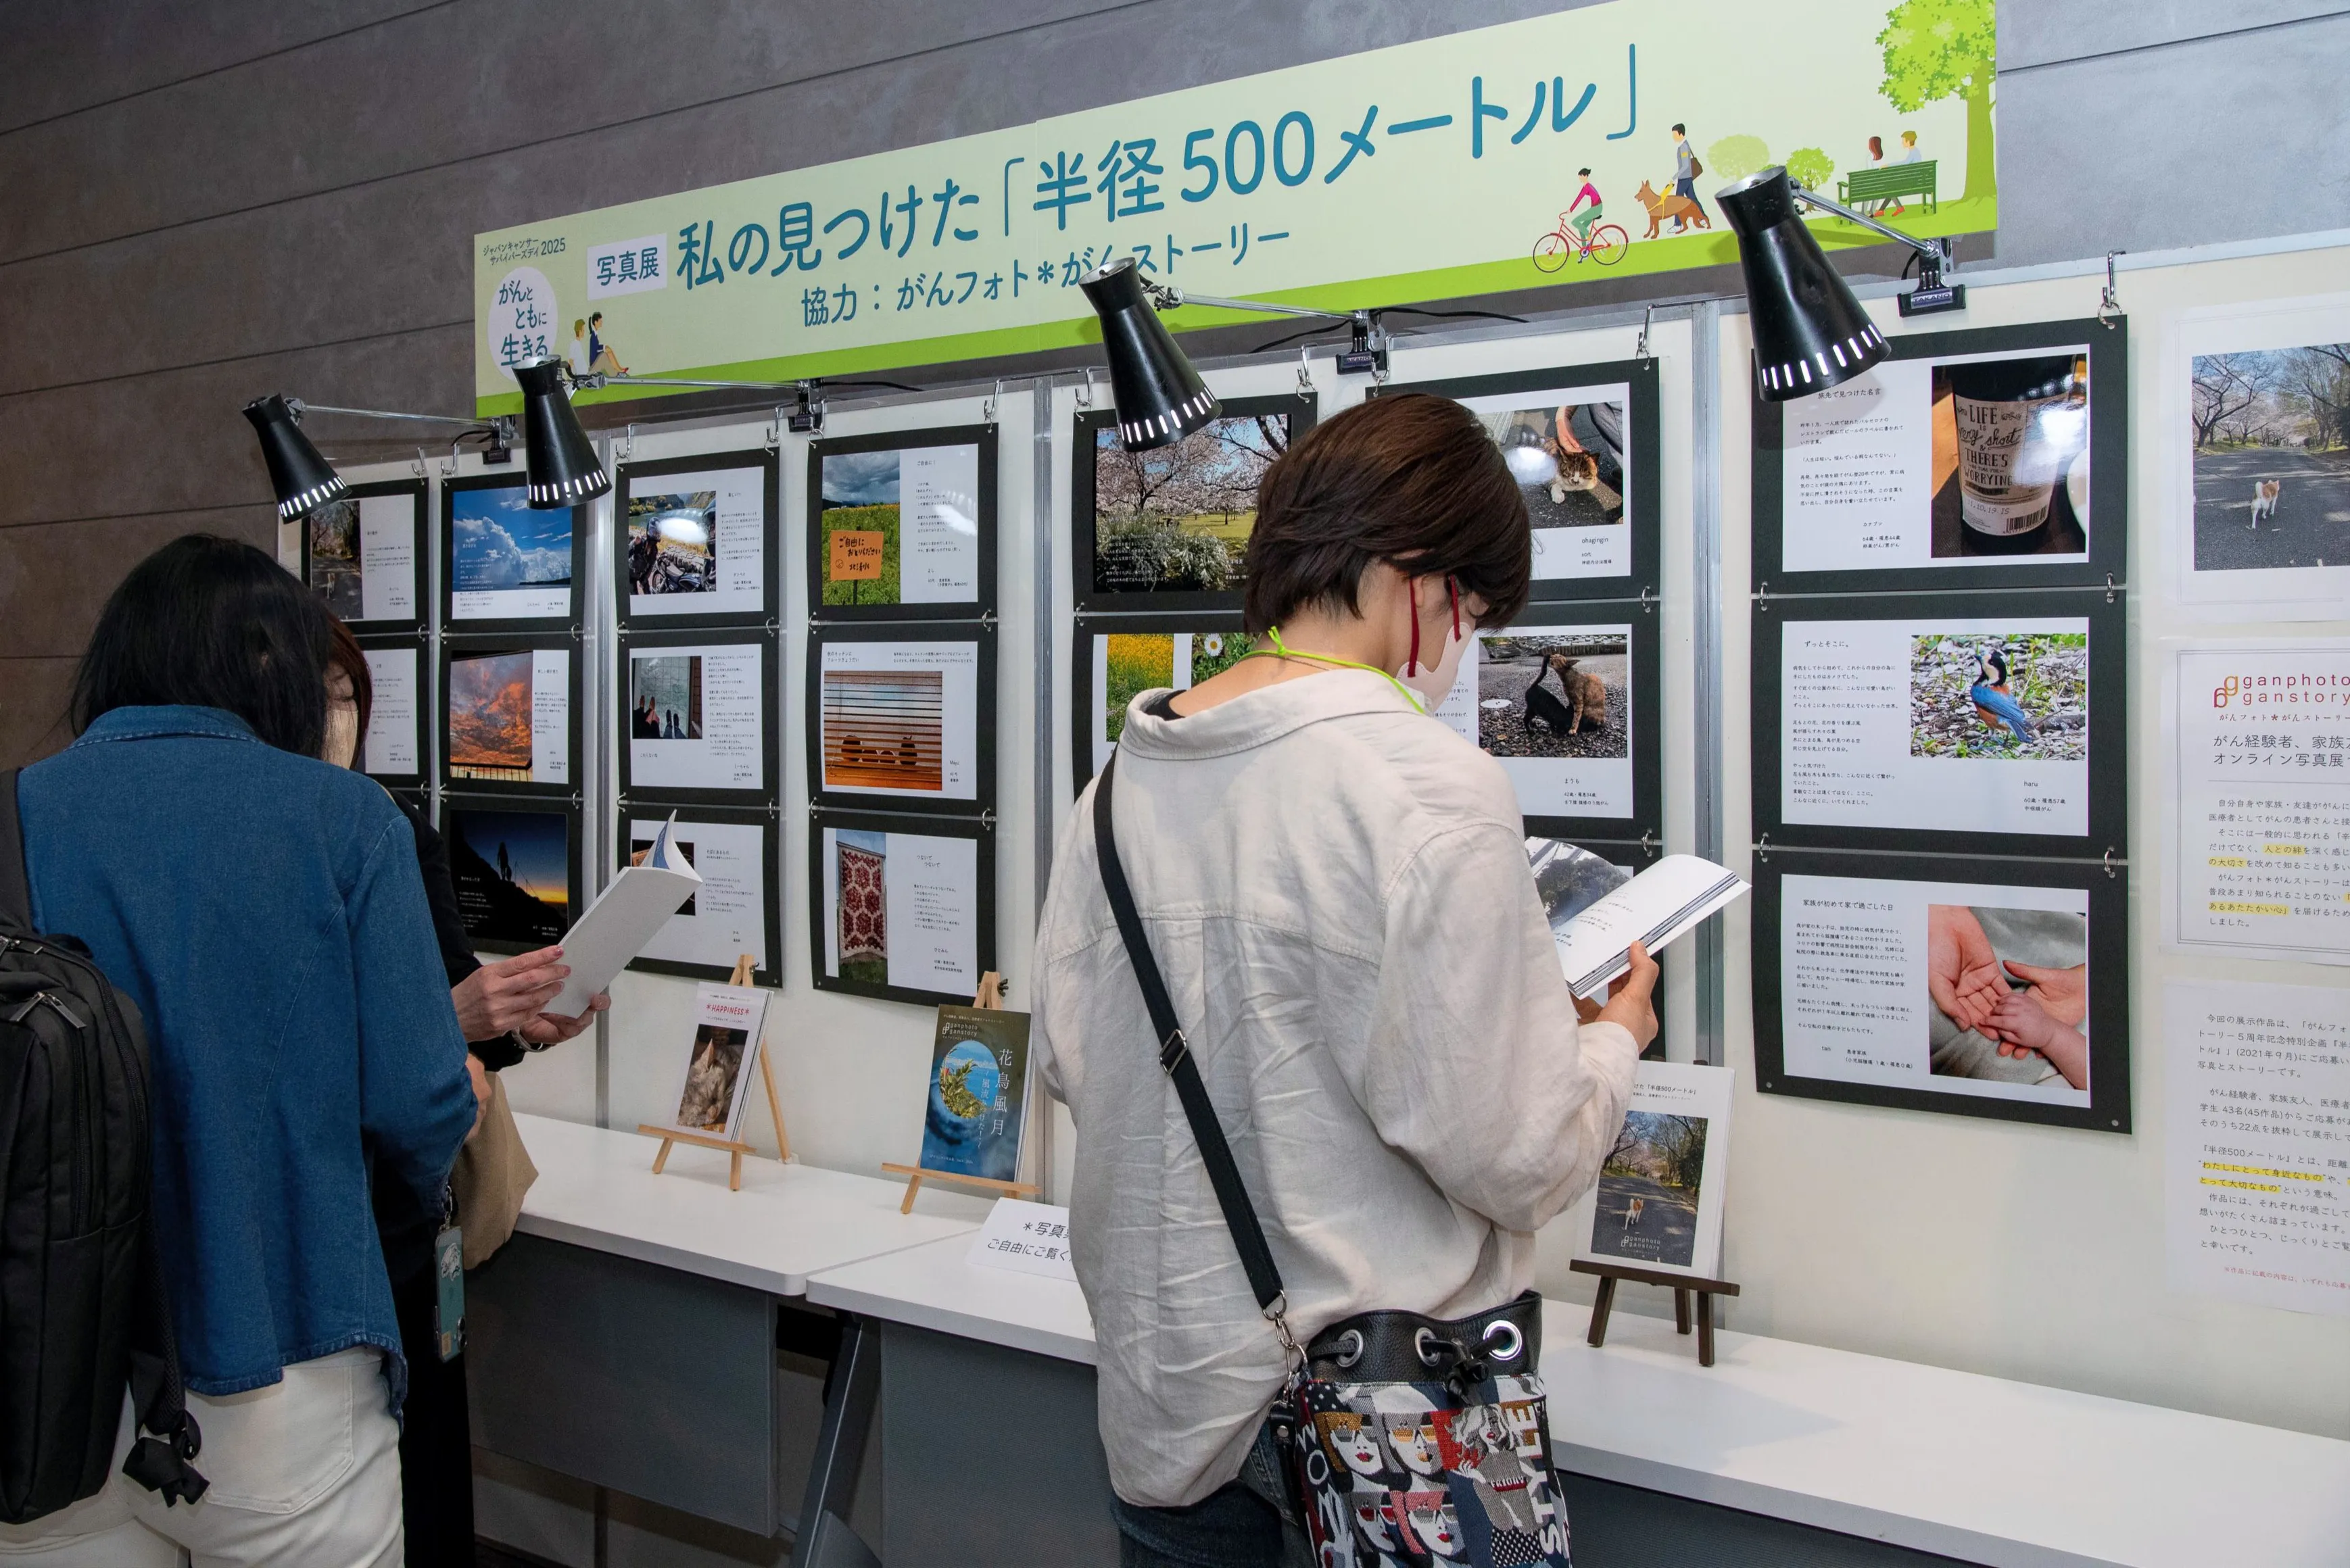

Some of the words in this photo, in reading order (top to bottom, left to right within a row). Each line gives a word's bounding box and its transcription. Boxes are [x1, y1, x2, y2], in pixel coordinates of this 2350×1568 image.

[483, 238, 539, 256] ジャパンキャンサー
[541, 237, 566, 255] 2025
[489, 247, 539, 266] サバイバーズデイ
[596, 247, 660, 286] 写真展
[802, 225, 1290, 328] 協力：がんフォトがストーリー
[499, 279, 533, 305] がんと
[515, 303, 548, 330] ともに
[500, 333, 548, 366] 生きる
[1817, 388, 1881, 399] 旅先で見つけた名言
[1969, 404, 1998, 424] LIFE
[1965, 447, 2009, 467] THERE'S
[839, 536, 865, 548] ご自由に
[1581, 536, 1608, 545] ohagingin
[1804, 640, 1849, 648] ずっとそこに。
[2243, 673, 2350, 689] ganphoto
[2243, 691, 2350, 706] ganstory
[2213, 734, 2350, 750] がん経験者、家族
[2213, 753, 2350, 768] オンライン写真展
[2218, 799, 2350, 810] 自分自身や家族・友達ががんに
[2209, 813, 2350, 826] 医療者としてがんの患者さんと接
[2209, 843, 2350, 857] だけでなく、人との絆を深く感じ
[2209, 858, 2350, 871] の大切さを改めて知ることも多い
[1802, 899, 1894, 911] 家族が初めて家で過ごした日
[2209, 917, 2250, 927] しました。
[711, 1004, 744, 1015] HAPPINESS
[2207, 1014, 2347, 1033] 今回の展示作品は、「がんフォ
[949, 1029, 978, 1037] ganstory
[2199, 1029, 2350, 1050] トーリー5周年記念特別企画『半
[2197, 1060, 2301, 1079] 写真とストーリーです。
[990, 1048, 1013, 1136] 花鳥風月
[2209, 1087, 2350, 1110] がん経験者、家族友人、医療者
[2199, 1102, 2219, 1113] 学生
[2208, 1193, 2350, 1218] 作品には、それぞれが過ごして
[2199, 1207, 2346, 1235] 想いがたくさん詰まっています。
[987, 1238, 1072, 1263] ご自由にご覧く
[2200, 1240, 2253, 1255] と幸いです。
